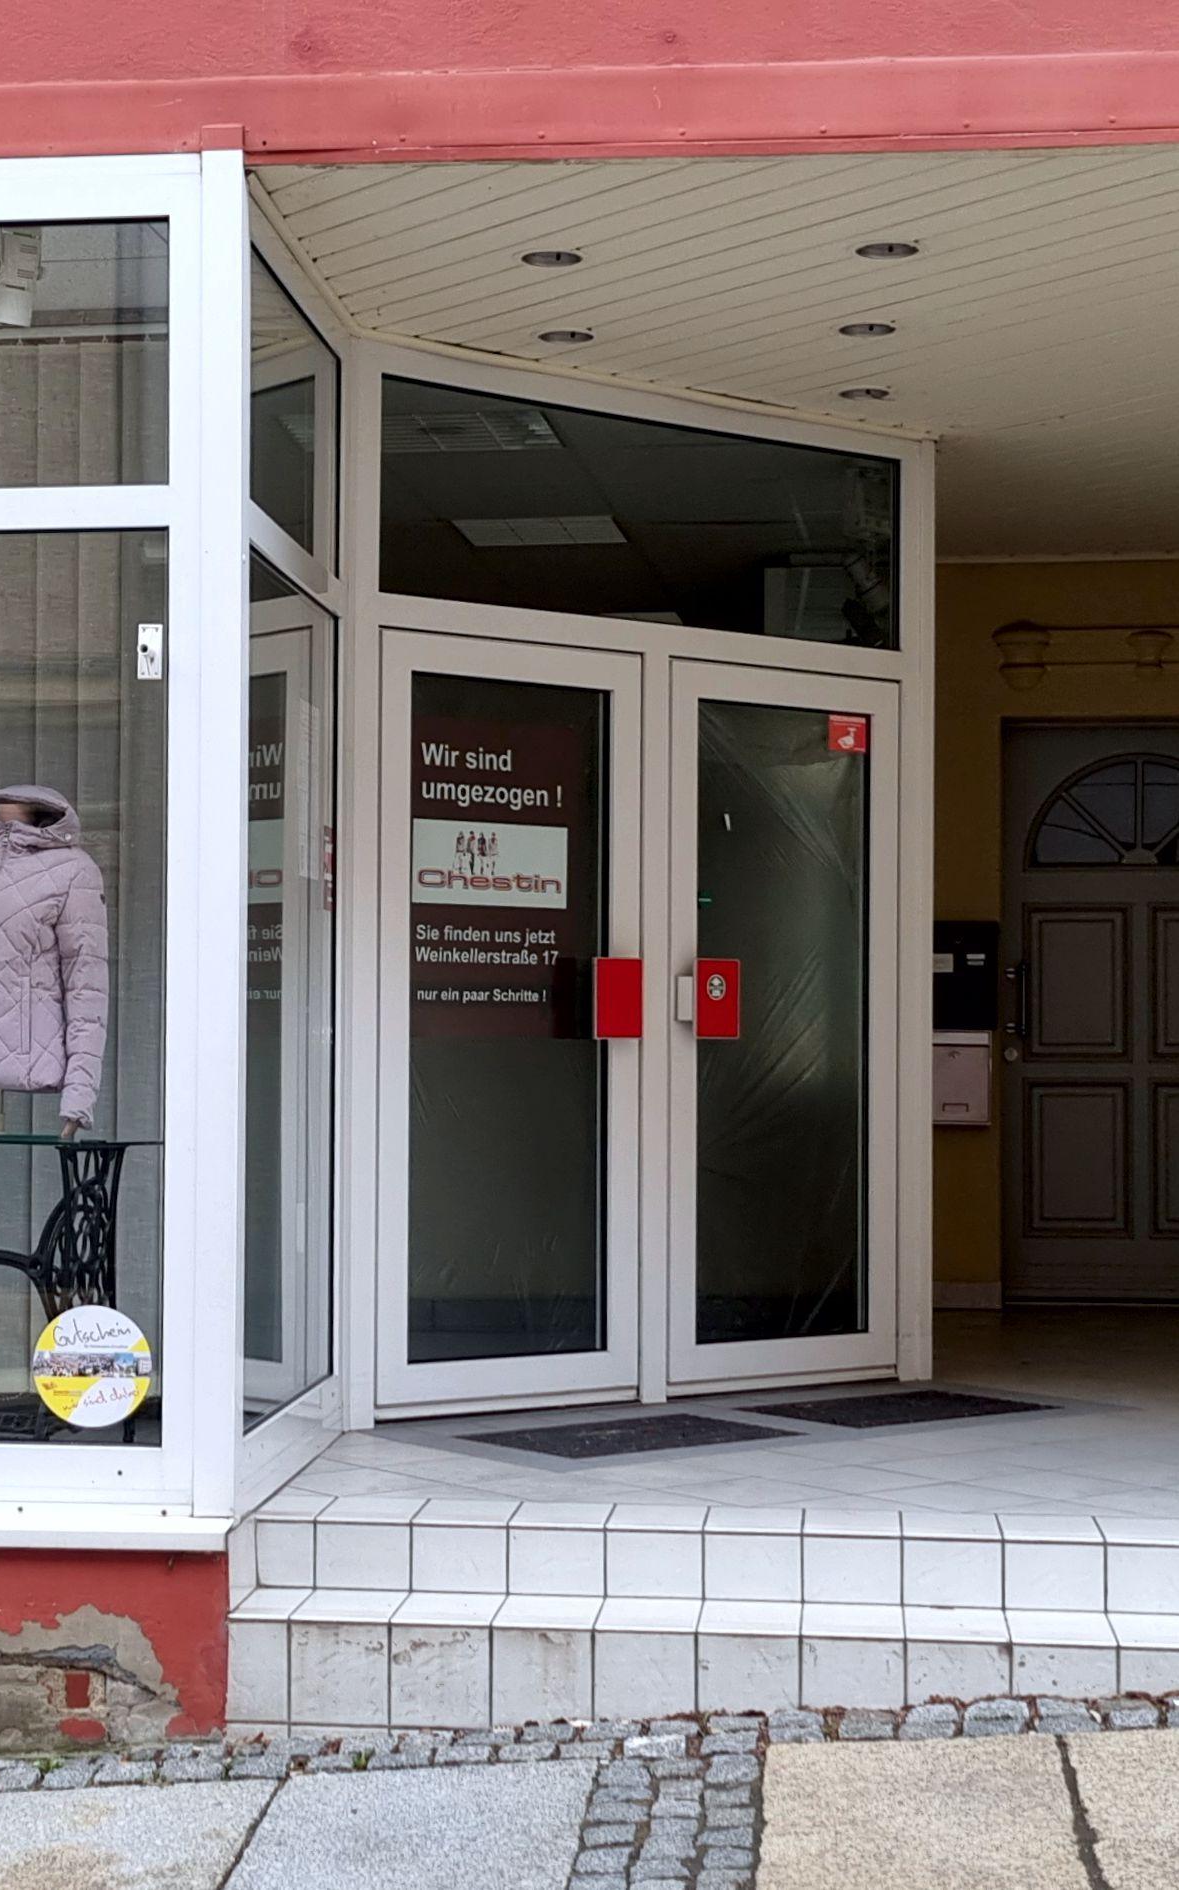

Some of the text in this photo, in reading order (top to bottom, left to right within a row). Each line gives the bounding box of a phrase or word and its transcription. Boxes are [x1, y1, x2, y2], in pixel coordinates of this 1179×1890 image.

[421, 742, 512, 772] Wir sind
[421, 780, 549, 811] umgezogen
[417, 868, 562, 894] Chestin
[416, 924, 556, 948] Sie finden uns jetzt
[415, 946, 558, 965] Weinkellerstraße 17
[417, 988, 437, 1001] nur
[441, 986, 459, 1001] ein
[462, 989, 490, 1004] paar
[492, 986, 539, 1003] Schritte
[53, 1319, 131, 1346] Gutschein
